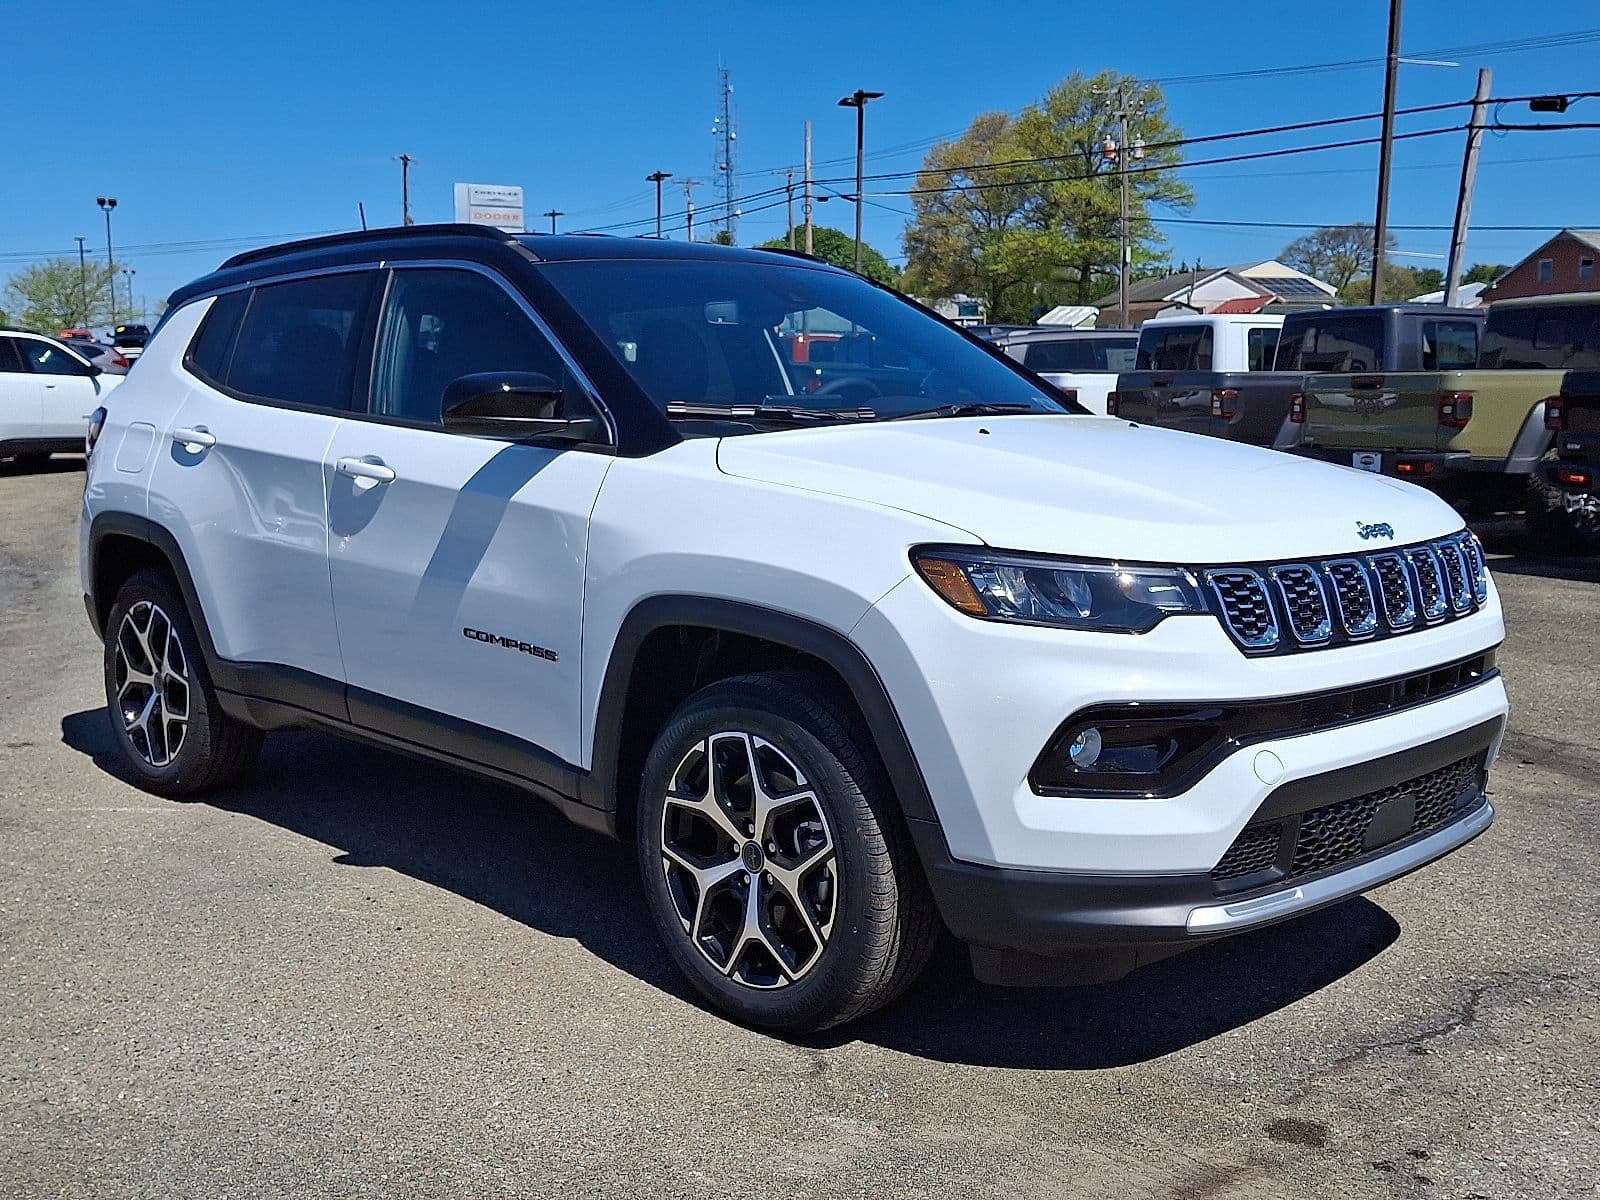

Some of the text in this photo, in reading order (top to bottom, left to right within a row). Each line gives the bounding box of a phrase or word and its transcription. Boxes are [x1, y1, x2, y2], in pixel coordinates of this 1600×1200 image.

[474, 212, 519, 221] DODGE
[1355, 521, 1394, 540] Jeep
[463, 627, 558, 662] COMPASS
